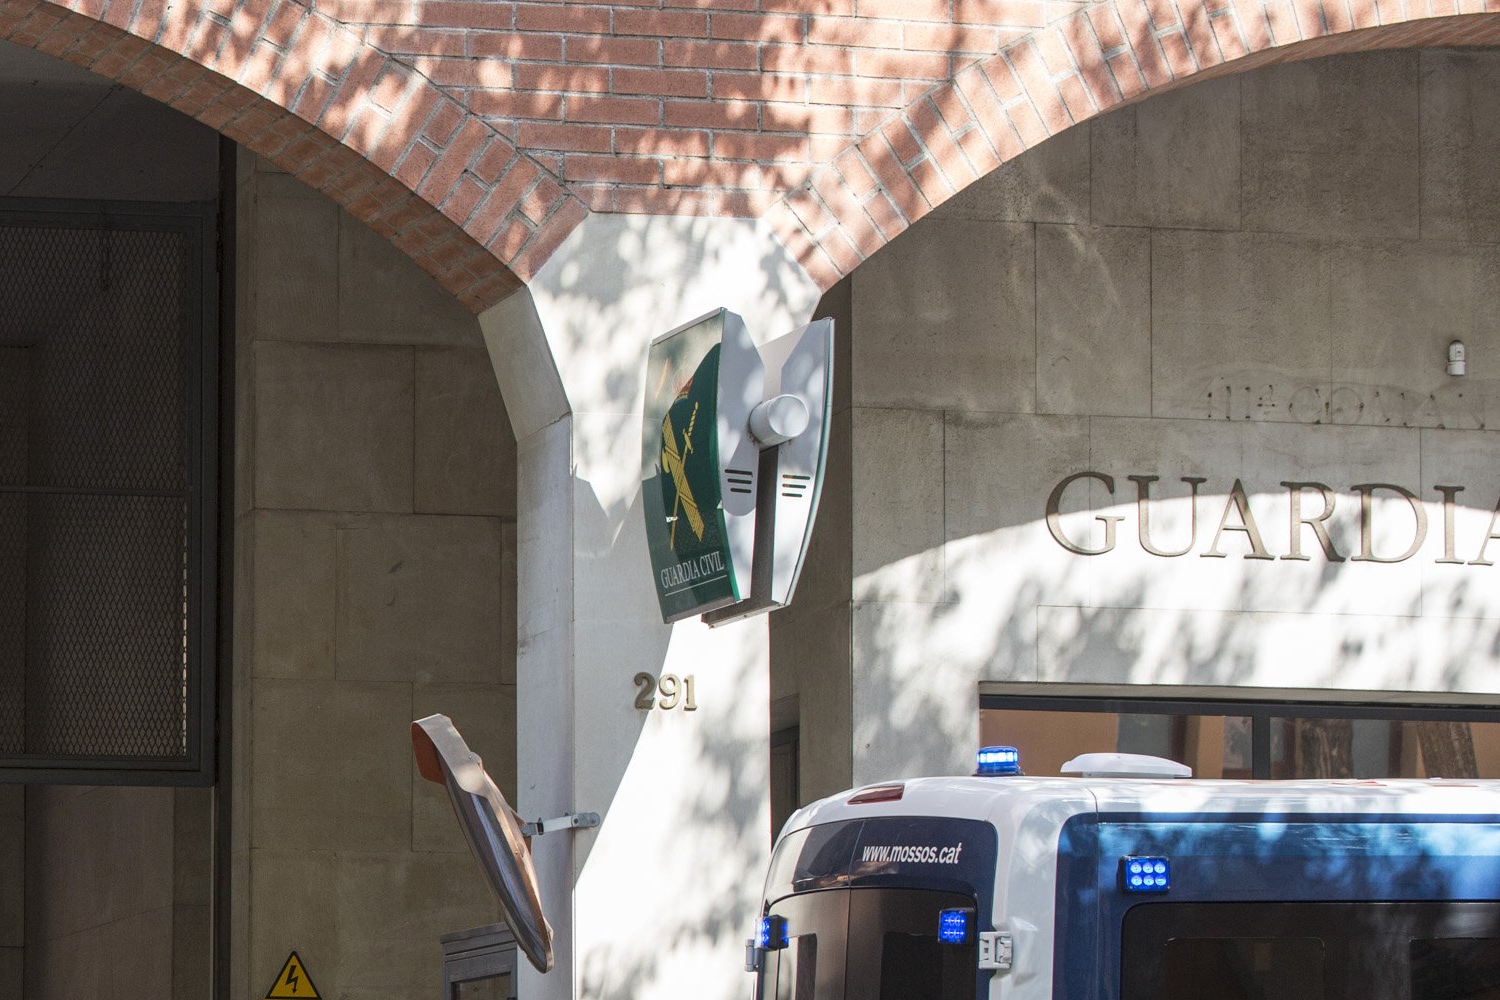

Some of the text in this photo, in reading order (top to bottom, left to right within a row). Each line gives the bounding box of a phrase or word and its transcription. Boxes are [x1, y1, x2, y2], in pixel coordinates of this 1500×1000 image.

[661, 551, 725, 589] GUARDIA CIVIL
[633, 671, 698, 712] 291
[862, 842, 962, 864] www.mossos.cat
